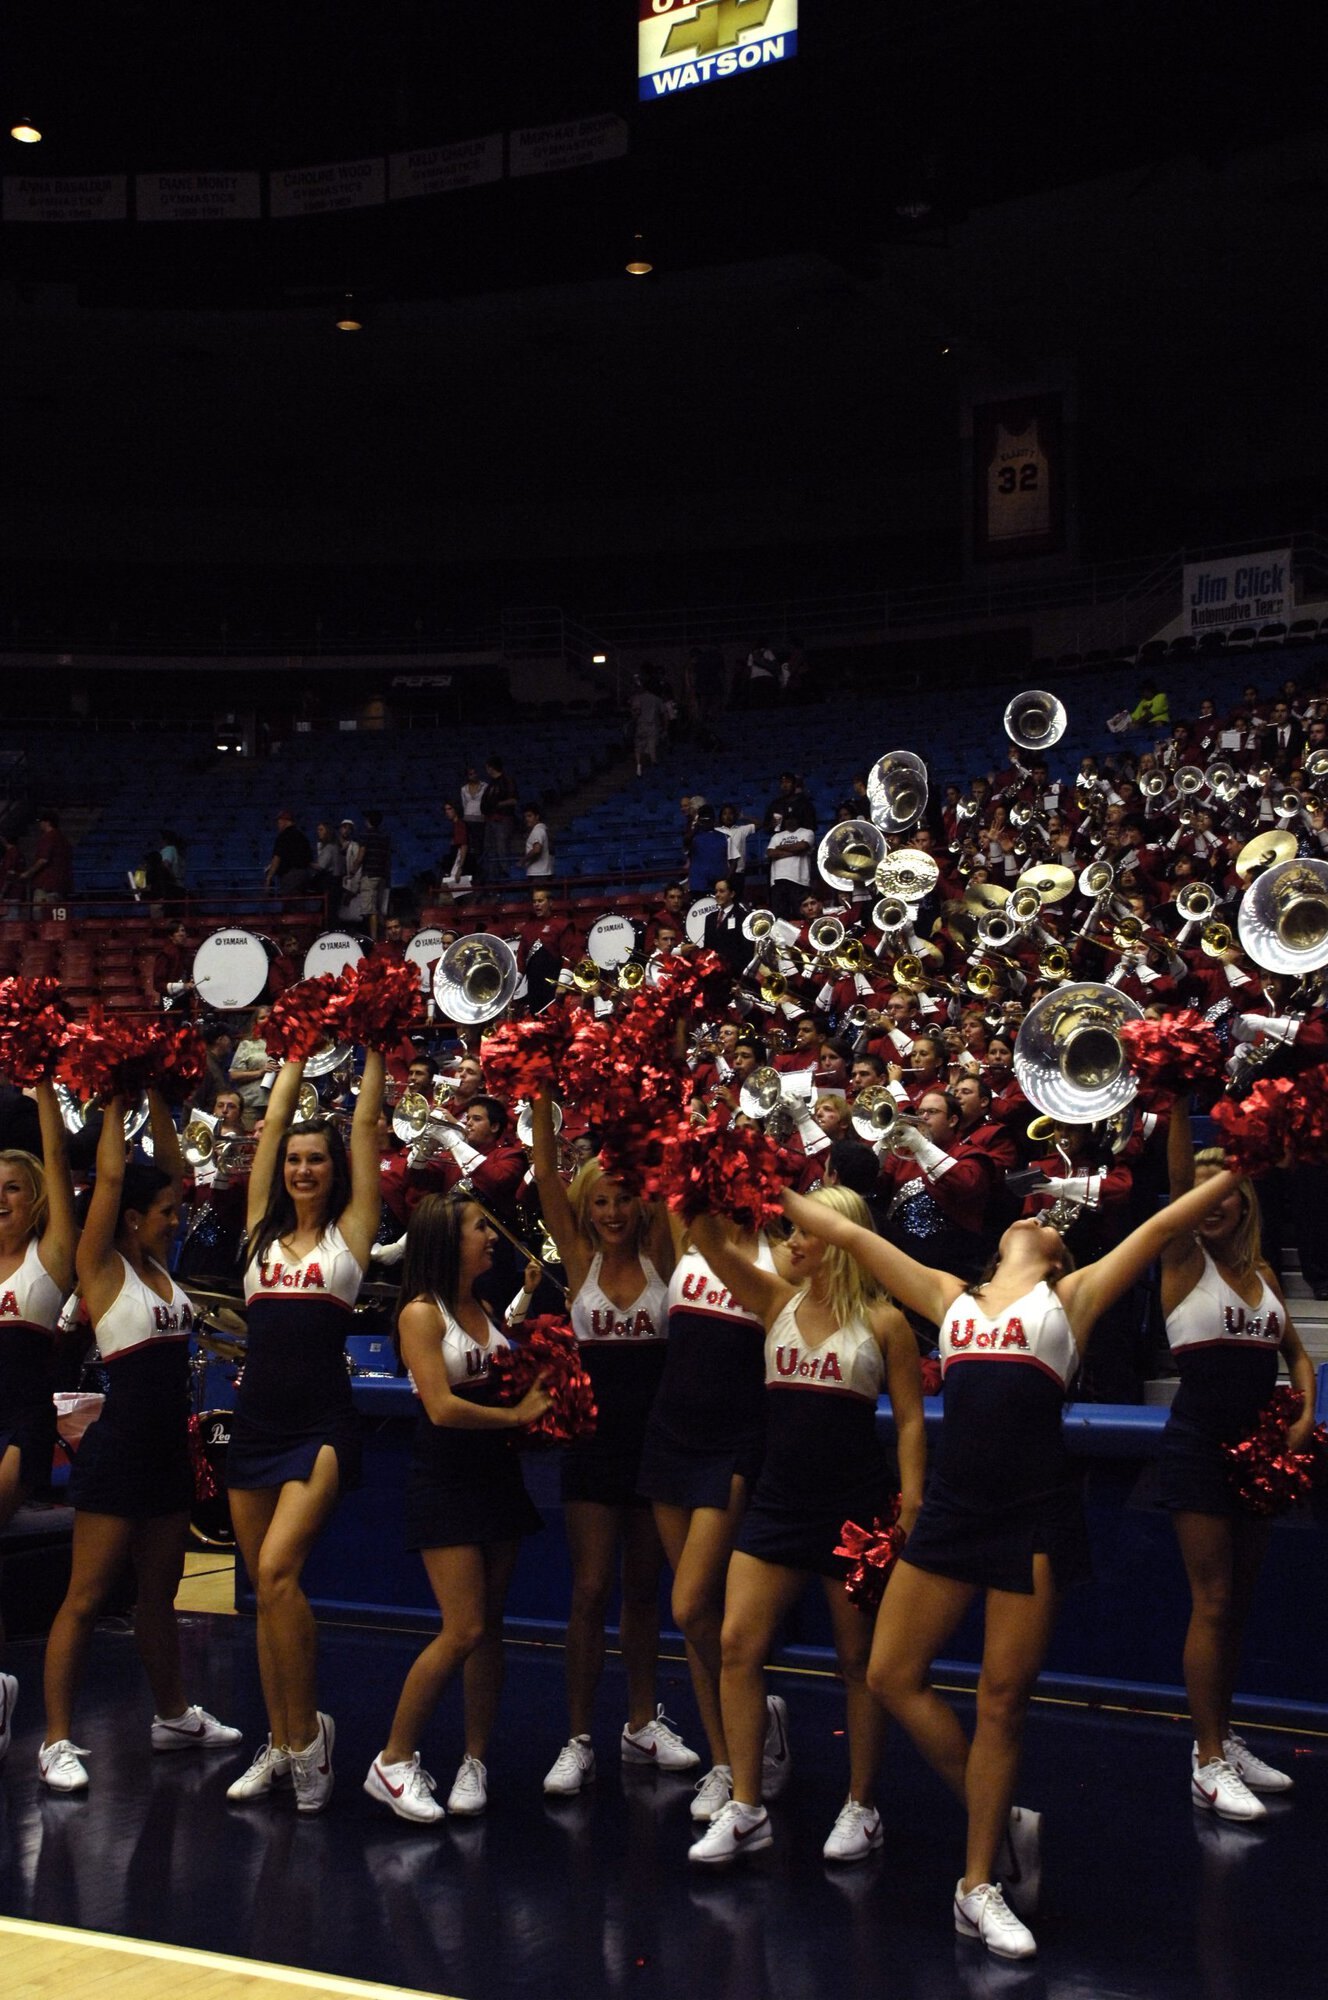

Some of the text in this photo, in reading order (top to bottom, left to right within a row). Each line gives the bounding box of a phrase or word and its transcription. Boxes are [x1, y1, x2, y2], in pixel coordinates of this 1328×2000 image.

[652, 36, 785, 94] WATSON
[998, 463, 1038, 494] 32
[1191, 563, 1284, 606] Jim Click
[1191, 602, 1251, 626] Automotive
[52, 908, 67, 921] 19
[603, 922, 624, 932] YAMAHA
[223, 937, 248, 945] YAMAHA
[326, 941, 350, 950] YAMAHA
[206, 1423, 231, 1444] Pea
